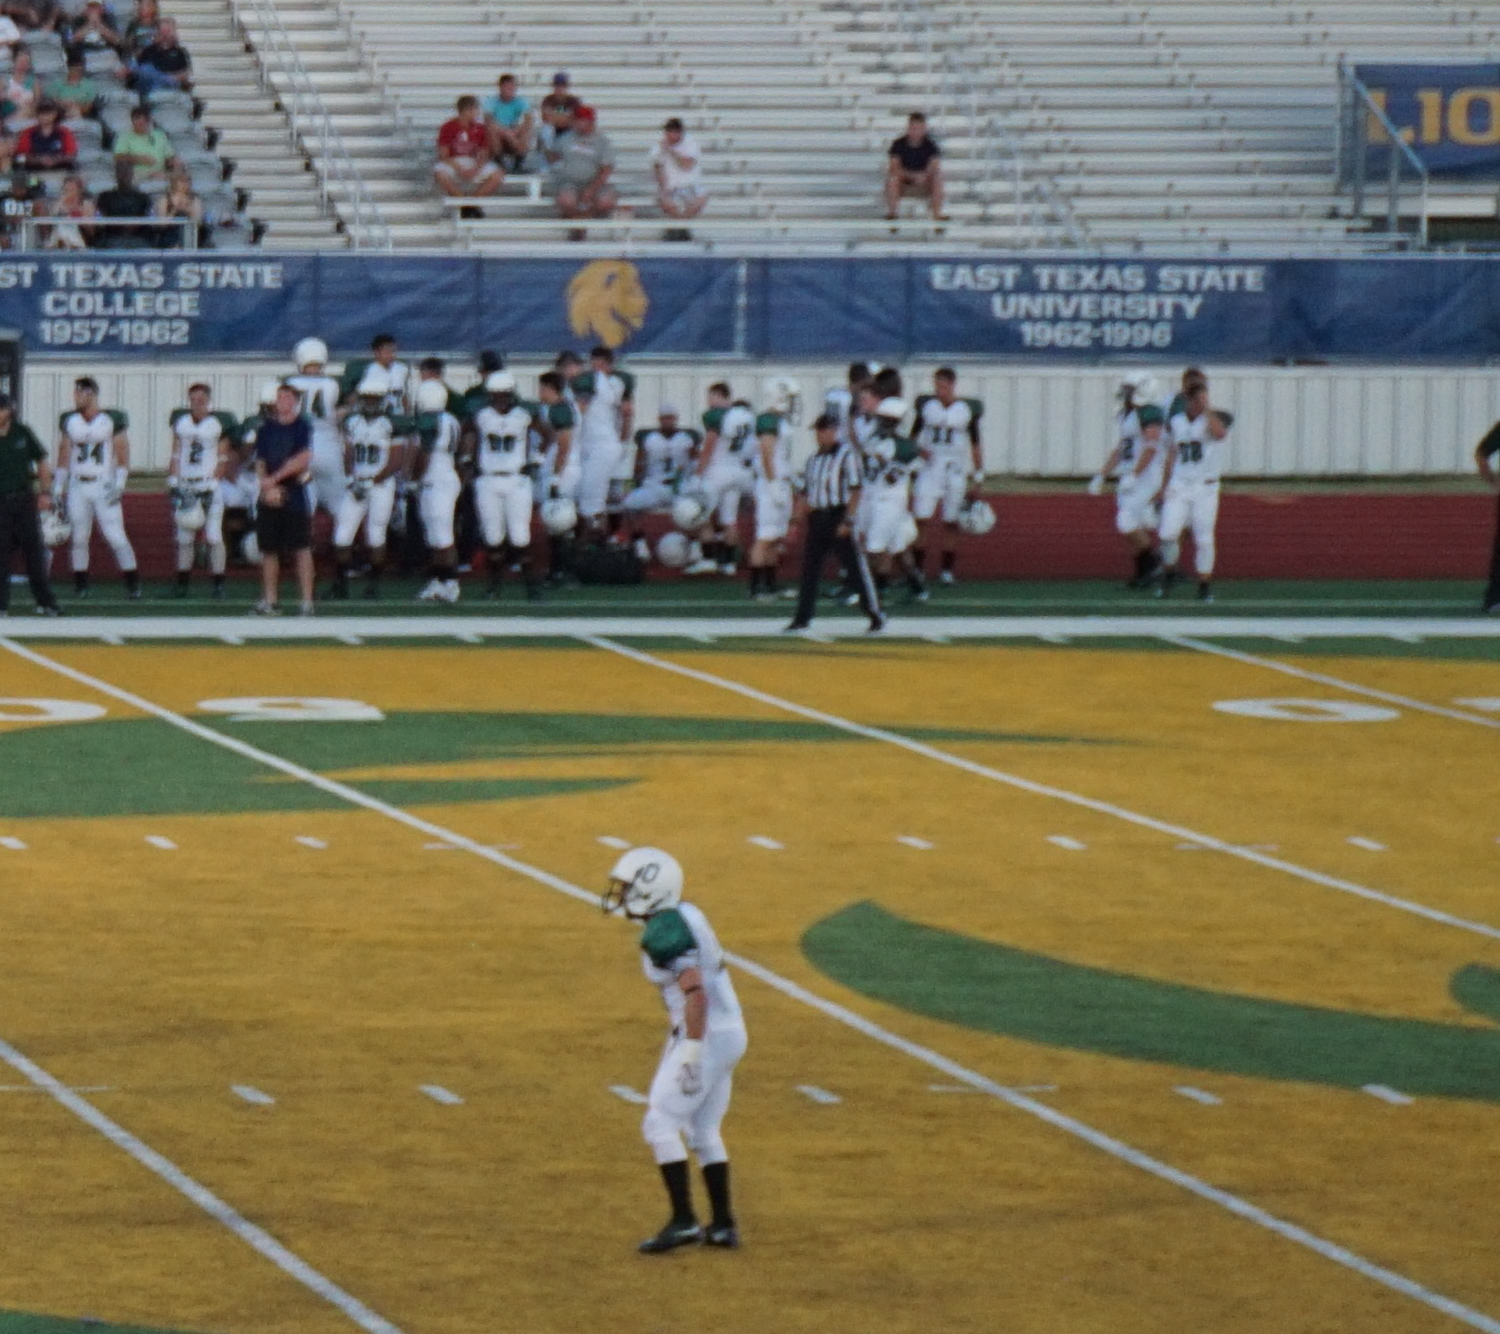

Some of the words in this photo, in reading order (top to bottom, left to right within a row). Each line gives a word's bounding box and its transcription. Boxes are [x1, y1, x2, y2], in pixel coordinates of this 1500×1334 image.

[51, 263, 164, 289] TEXAS
[176, 263, 284, 289] STATE
[930, 265, 1022, 292] EAST
[1033, 265, 1147, 292] TEXAS
[1157, 266, 1265, 292] STATE
[40, 291, 200, 317] COLLEGE
[991, 293, 1203, 320] UNIVERSITY
[38, 320, 190, 345] 1957-1962
[1020, 322, 1172, 348] 1962-1996
